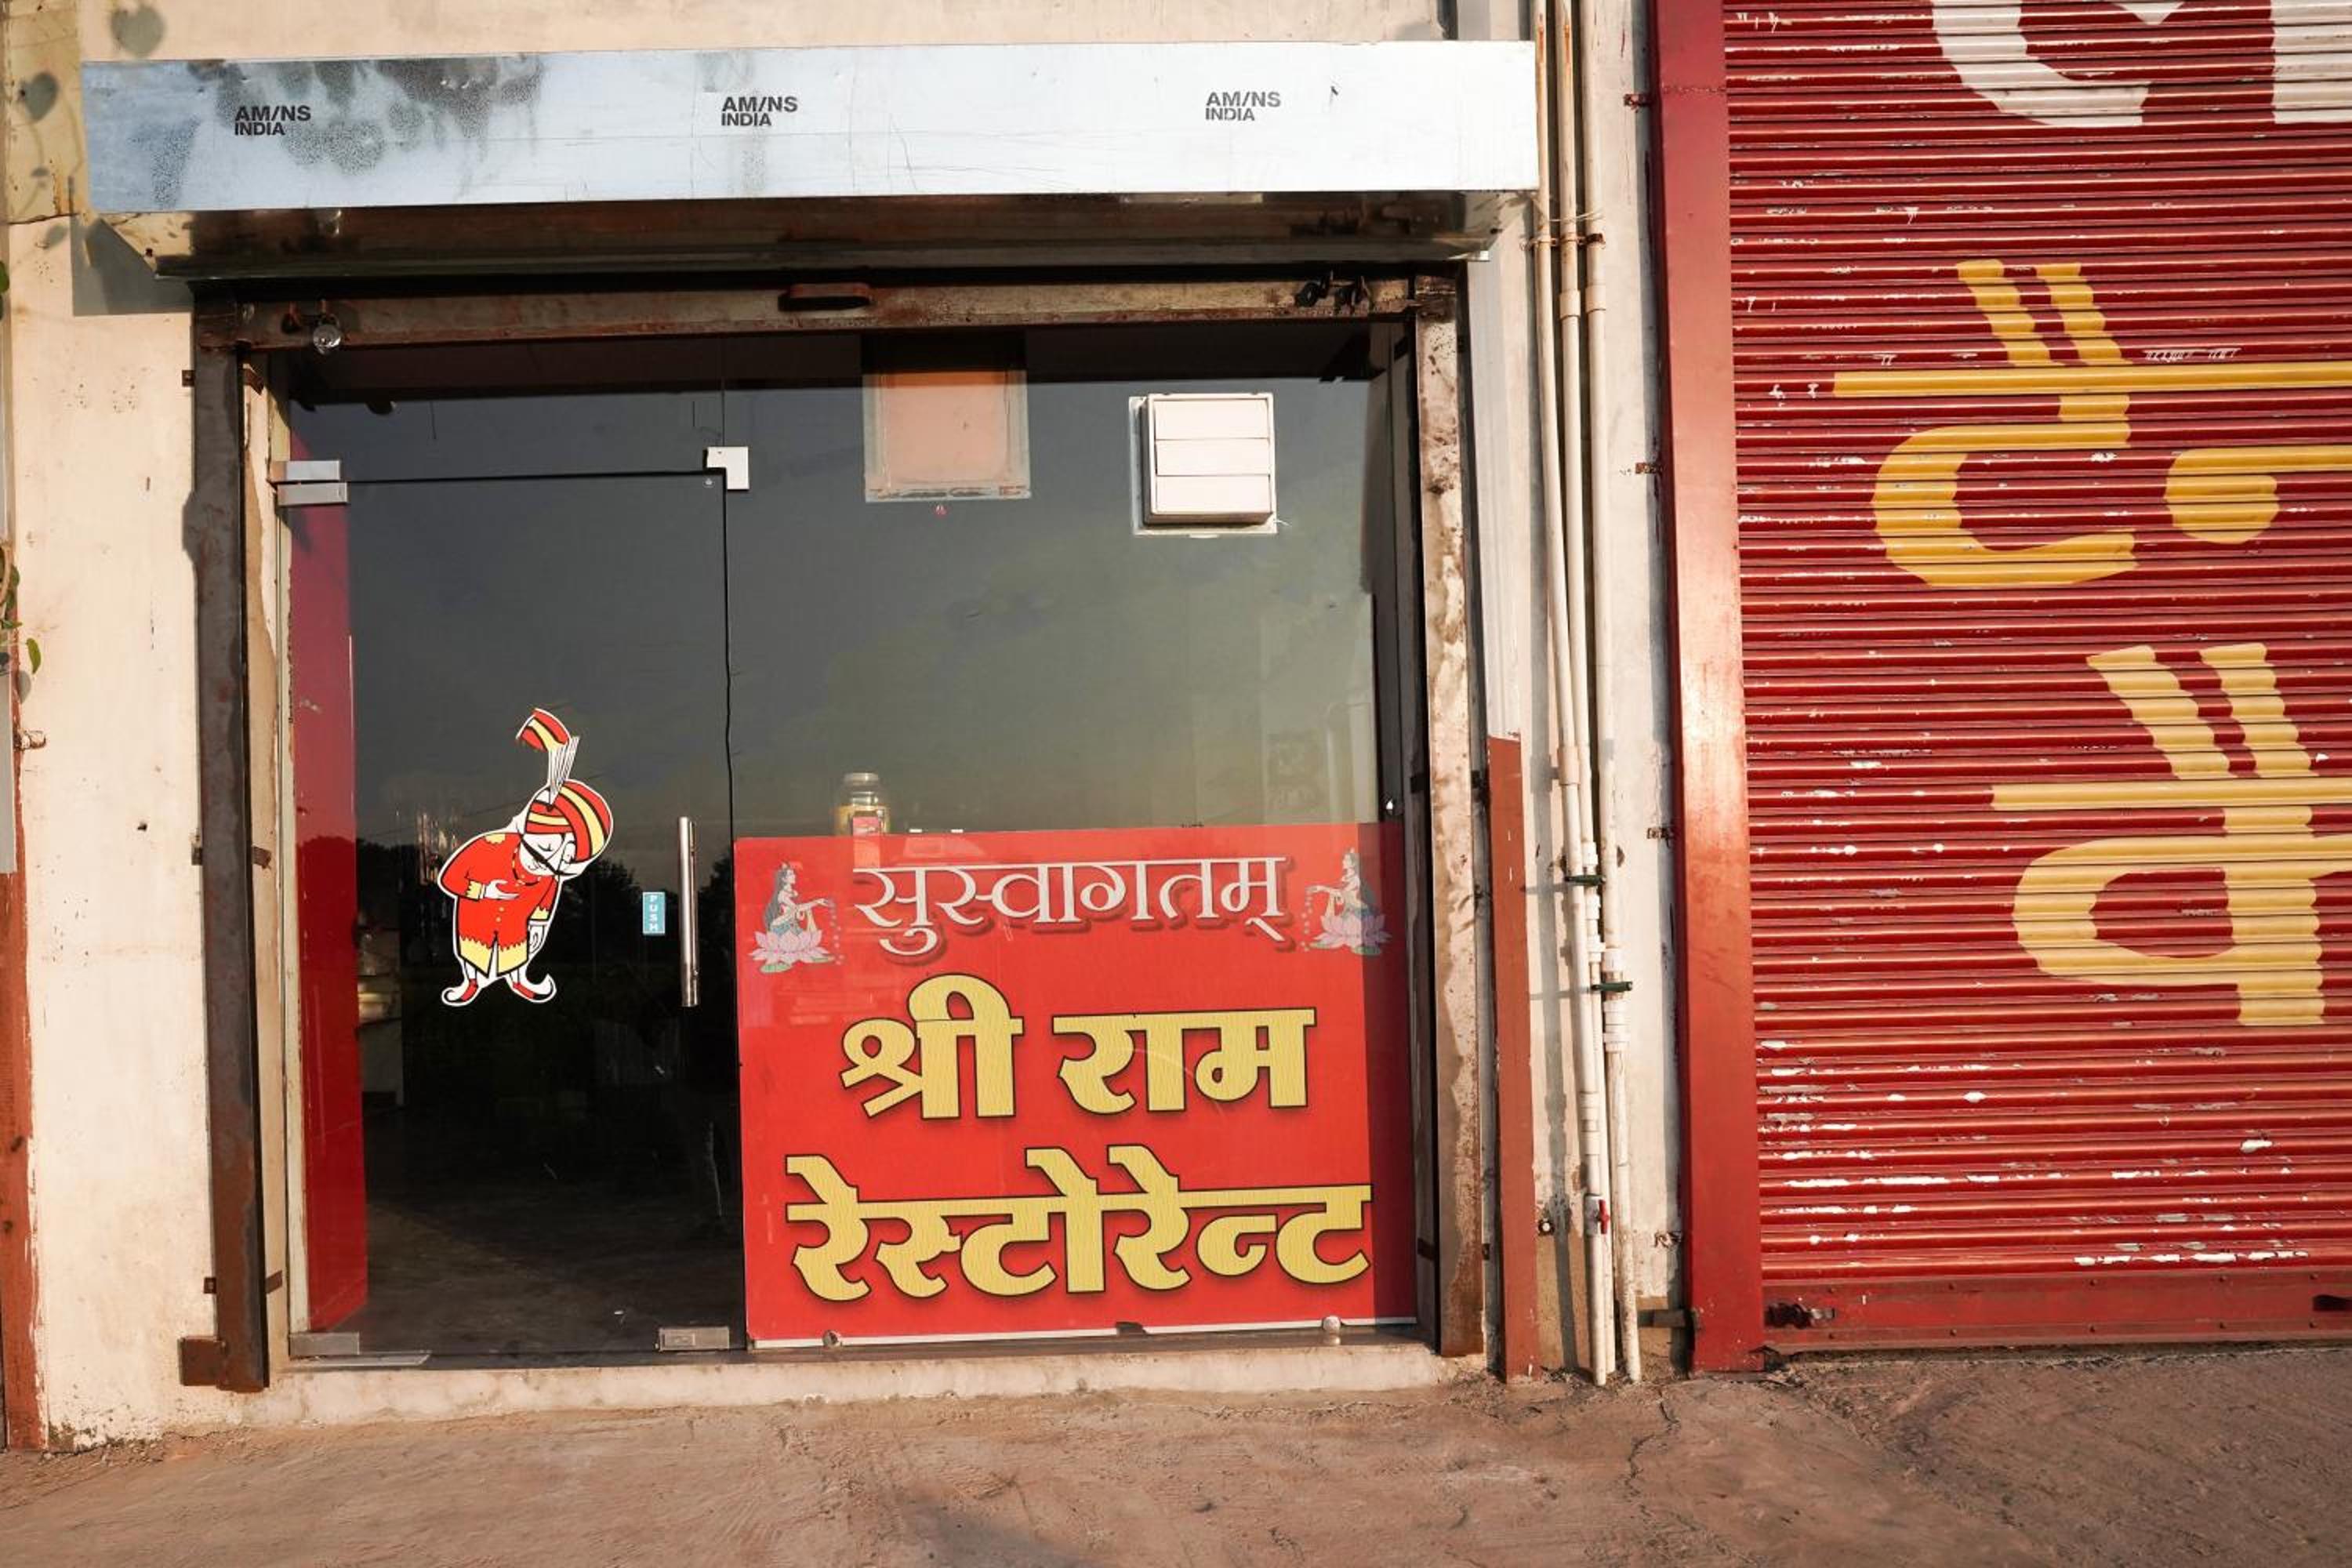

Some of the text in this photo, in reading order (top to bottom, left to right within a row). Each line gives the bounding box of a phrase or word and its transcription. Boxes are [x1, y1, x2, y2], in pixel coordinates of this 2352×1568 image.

[722, 96, 798, 113] AM/NS
[1206, 91, 1281, 107] AM/NS
[235, 104, 311, 122] AM/NS
[721, 112, 772, 126] INDIA
[1205, 107, 1255, 122] INDIA
[234, 122, 285, 136] INDIA
[853, 856, 1287, 956] सुस्वागतम्
[840, 973, 1318, 1120] श्री राम
[786, 1144, 1372, 1302] रेस्टोरेन्ट
